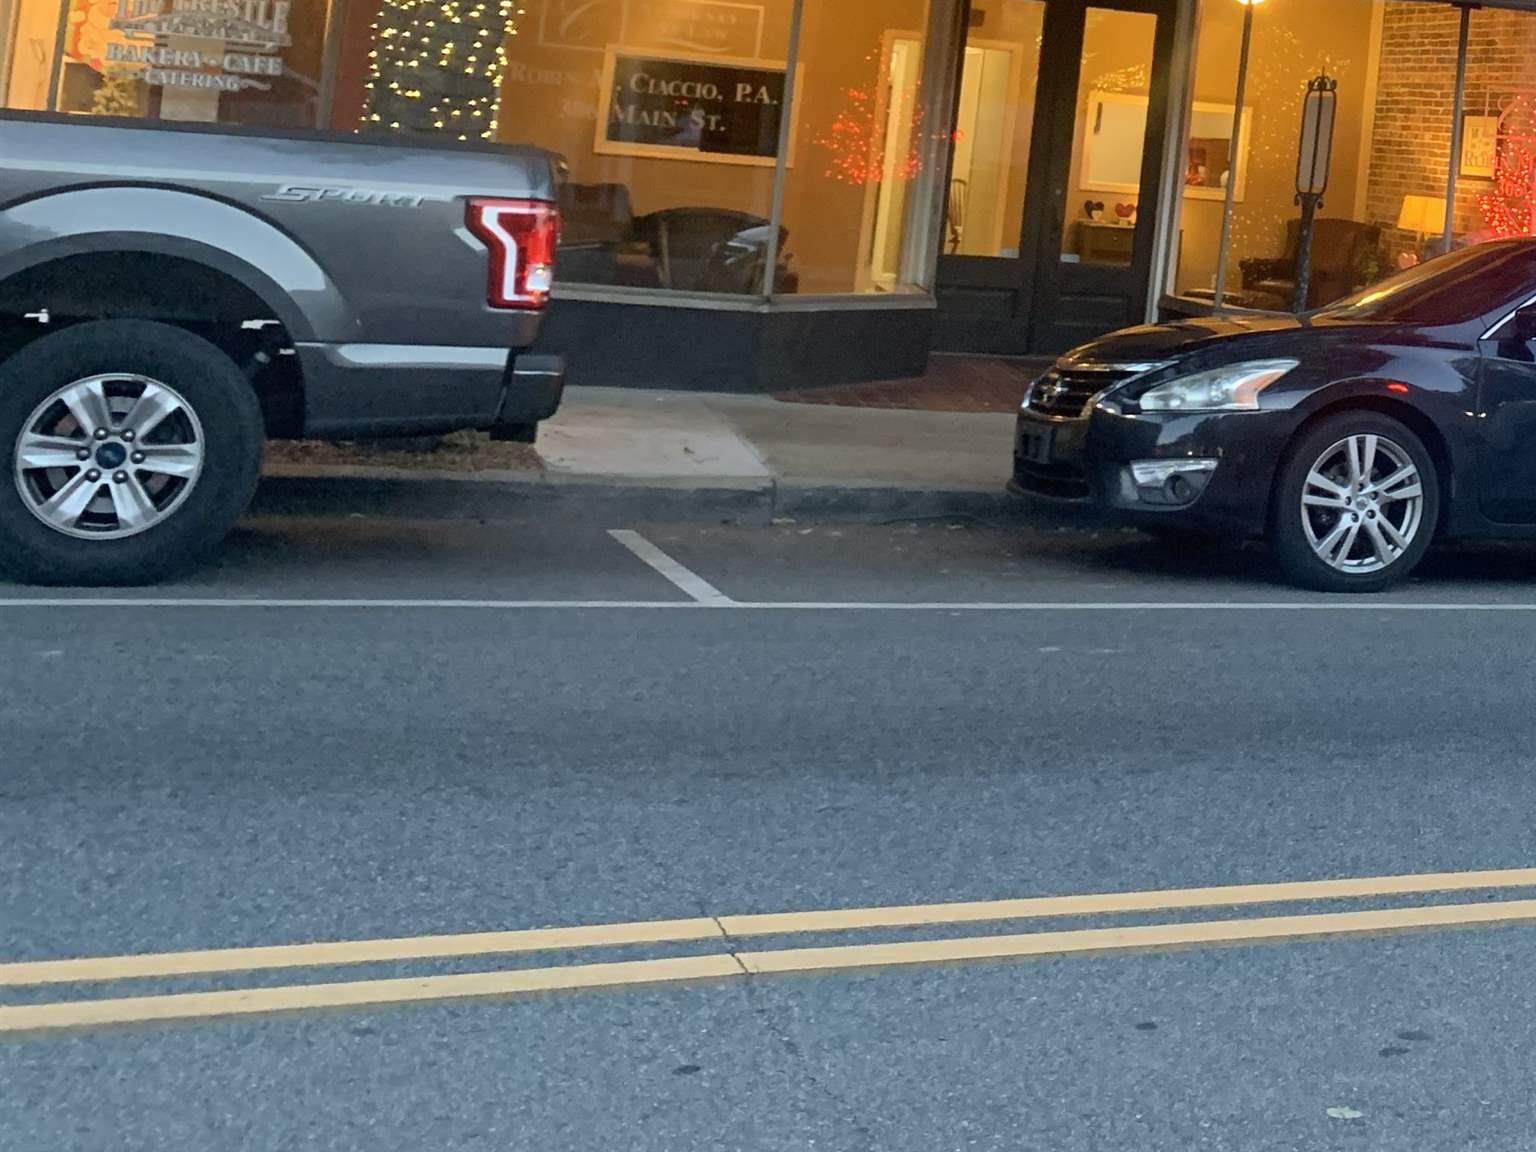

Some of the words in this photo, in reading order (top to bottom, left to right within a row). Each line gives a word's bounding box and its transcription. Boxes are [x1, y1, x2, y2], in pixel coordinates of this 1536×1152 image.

[105, 41, 204, 68] BAKERY
[222, 51, 284, 76] CAFE
[144, 67, 241, 92] CATERING
[629, 72, 724, 102] CIACCIO,
[734, 82, 779, 105] P.A.
[611, 103, 677, 128] MAIN
[689, 108, 727, 132] ST.
[260, 185, 425, 208] SPORT
